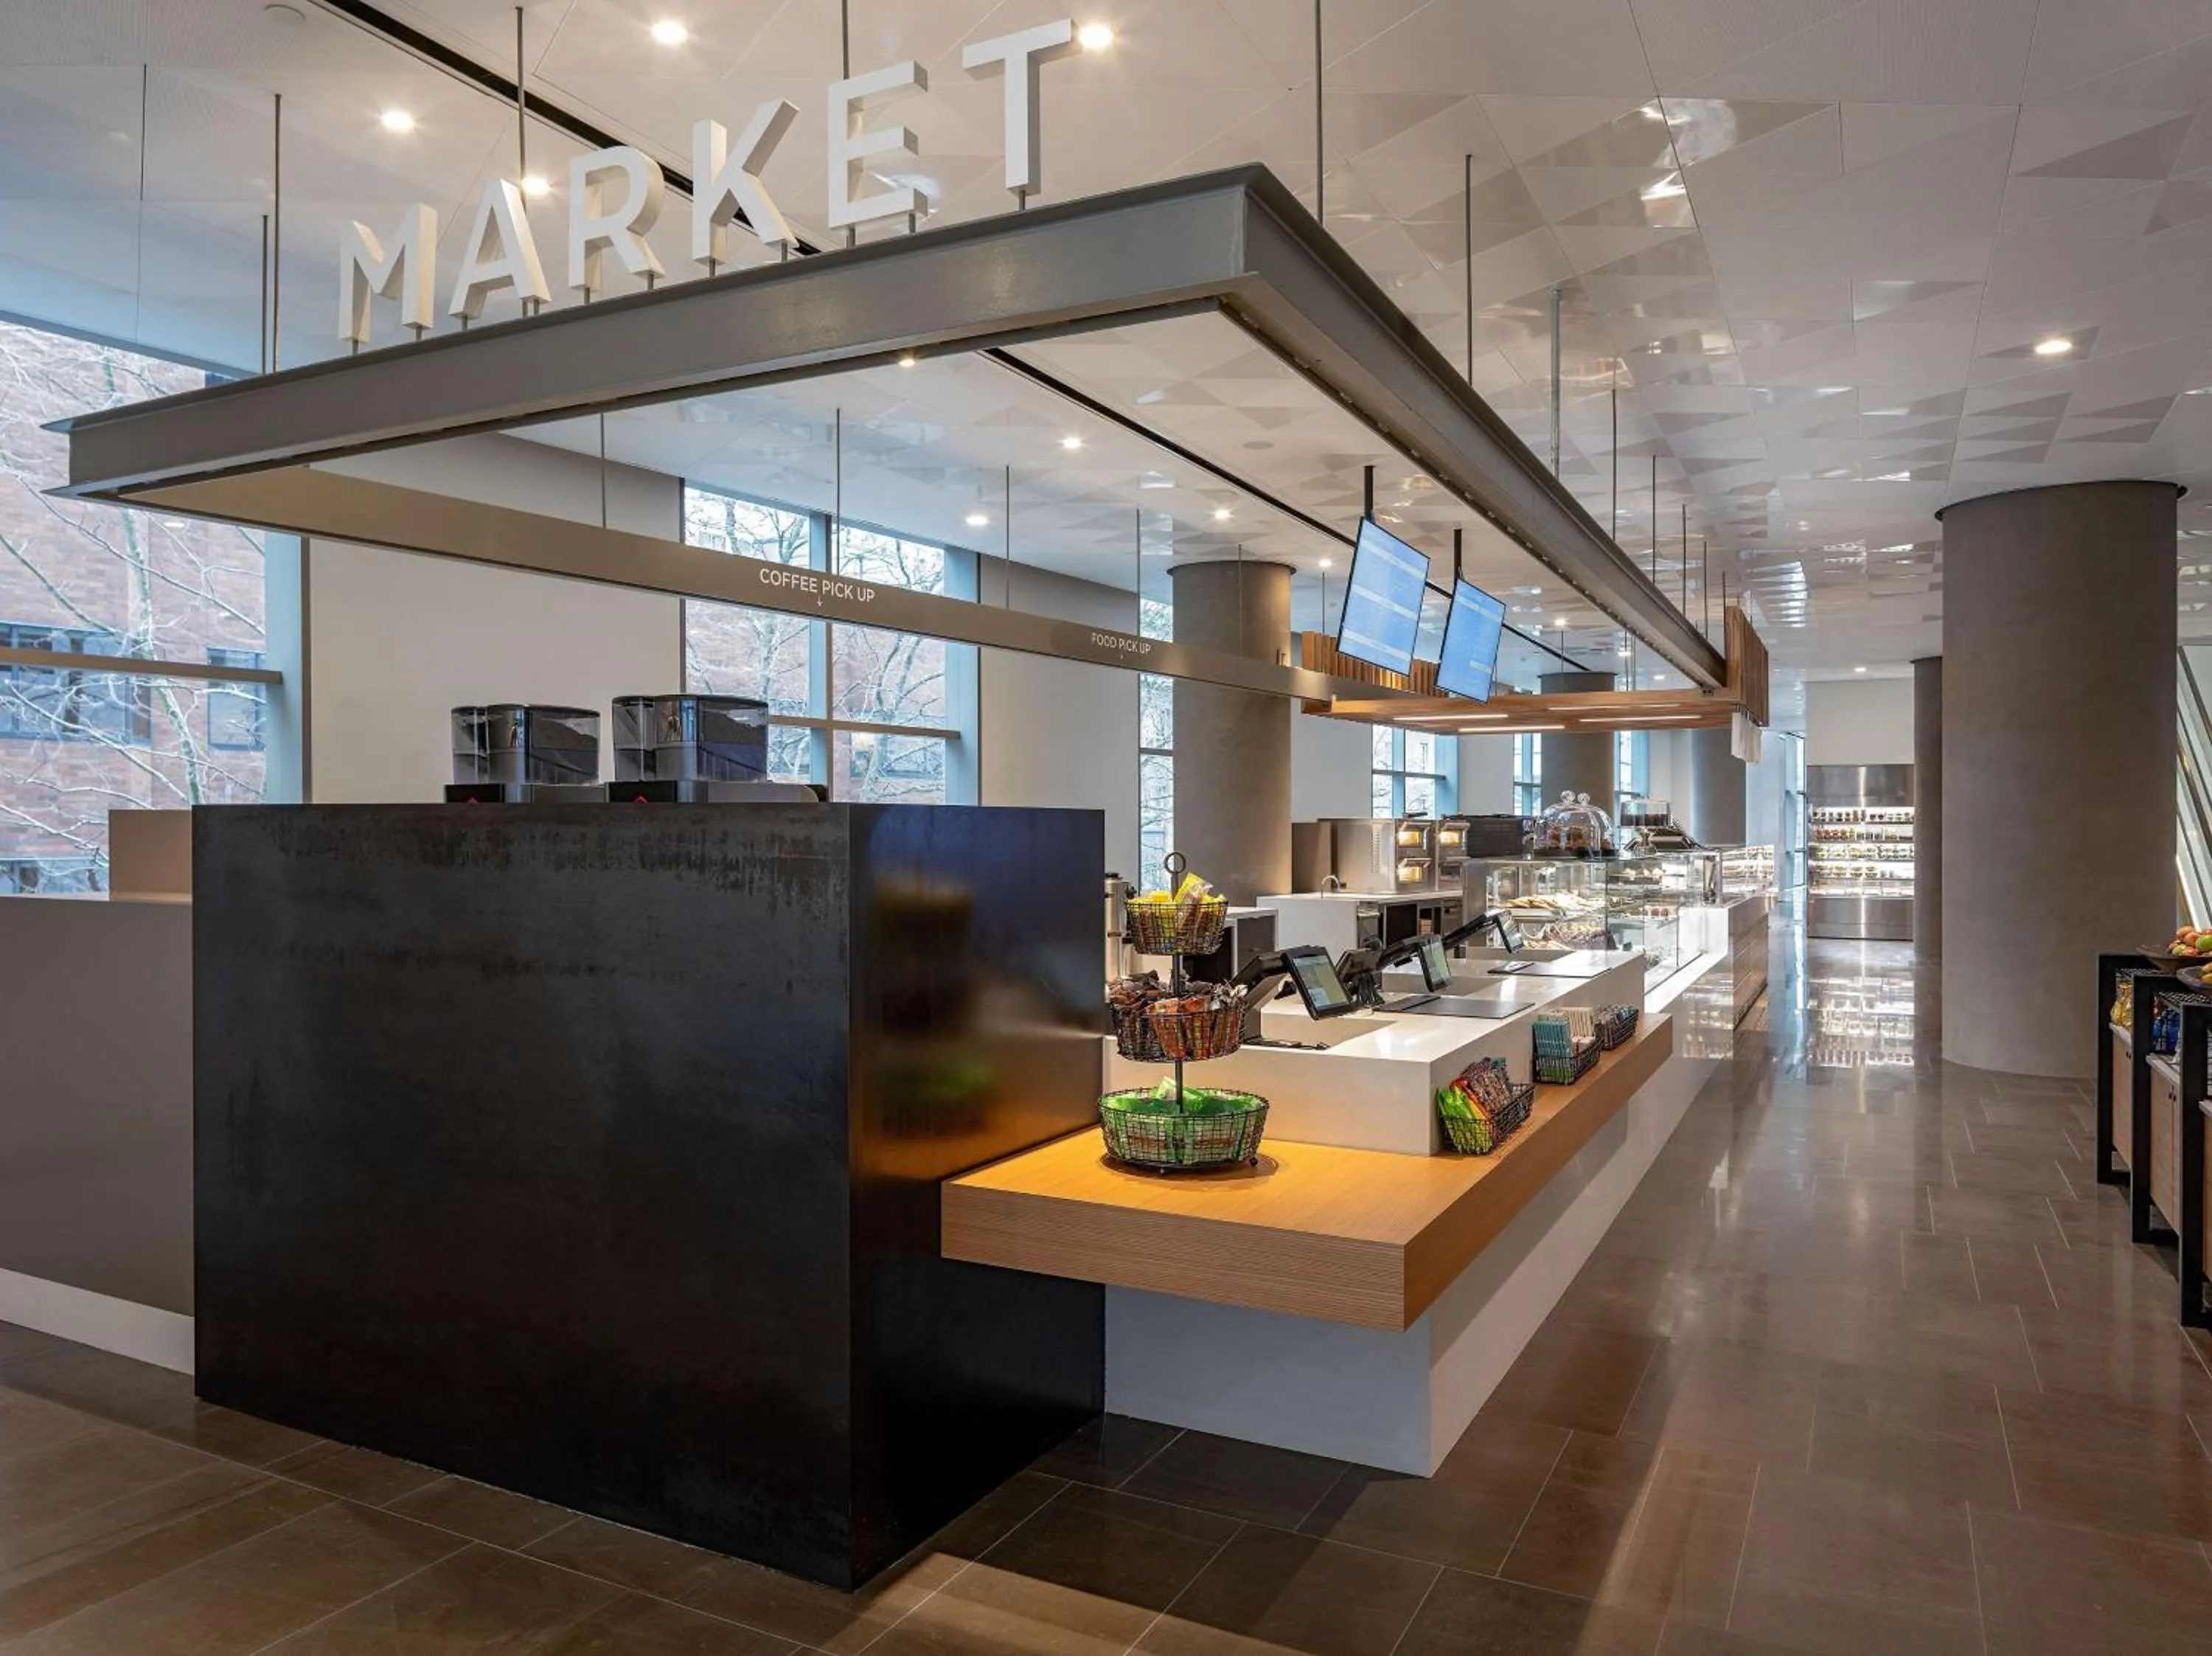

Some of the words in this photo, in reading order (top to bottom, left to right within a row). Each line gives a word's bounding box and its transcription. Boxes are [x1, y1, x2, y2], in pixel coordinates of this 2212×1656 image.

[337, 18, 1072, 344] MARKET
[759, 568, 818, 593] COFFEE
[822, 580, 854, 599] PICK
[858, 587, 875, 602] UP
[1091, 632, 1117, 648] FOOD
[1119, 638, 1138, 653] PICK
[1140, 642, 1151, 655] UP
